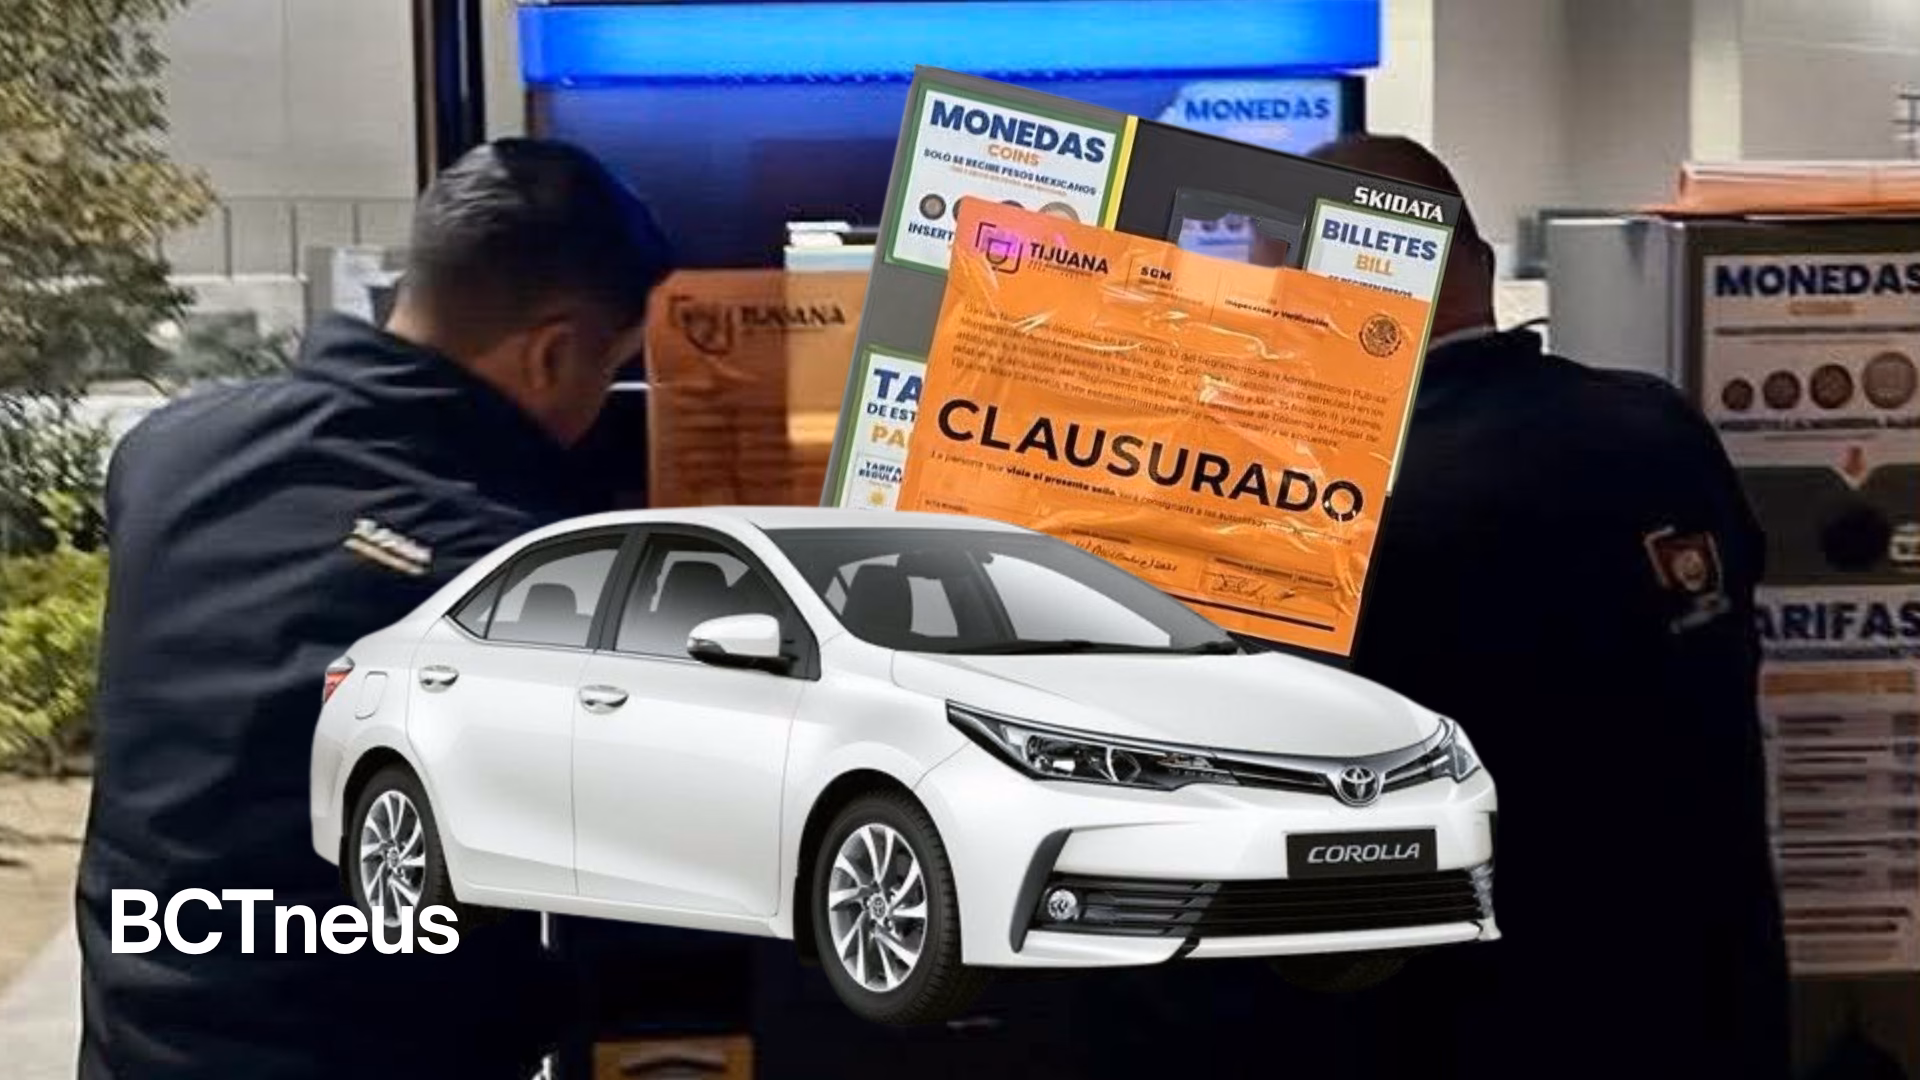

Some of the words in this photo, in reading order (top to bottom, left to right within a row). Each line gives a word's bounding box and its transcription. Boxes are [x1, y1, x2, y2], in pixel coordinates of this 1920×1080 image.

[1185, 98, 1331, 122] MONEDAS
[930, 99, 1106, 163] MONEDAS
[987, 143, 1040, 166] COINS
[924, 148, 950, 162] SOLO
[952, 155, 964, 165] SE
[965, 157, 1000, 173] RECIBE
[1002, 166, 1034, 181] PESOS
[1035, 174, 1097, 196] MEXICANOS
[1353, 186, 1444, 223] SKIDATA
[1322, 219, 1438, 261] BILLETES
[1030, 243, 1109, 275] TIJUANA
[1355, 254, 1393, 276] BILL
[1140, 265, 1172, 281] SGM
[1715, 264, 1920, 297] MONEDAS
[867, 403, 886, 417] DE
[870, 424, 914, 450] PA
[866, 460, 902, 475] TARIFA
[938, 398, 1365, 523] CLAUSURADO
[1032, 472, 1043, 481] el
[1043, 474, 1089, 491] presente
[1306, 841, 1421, 865] COROLLA
